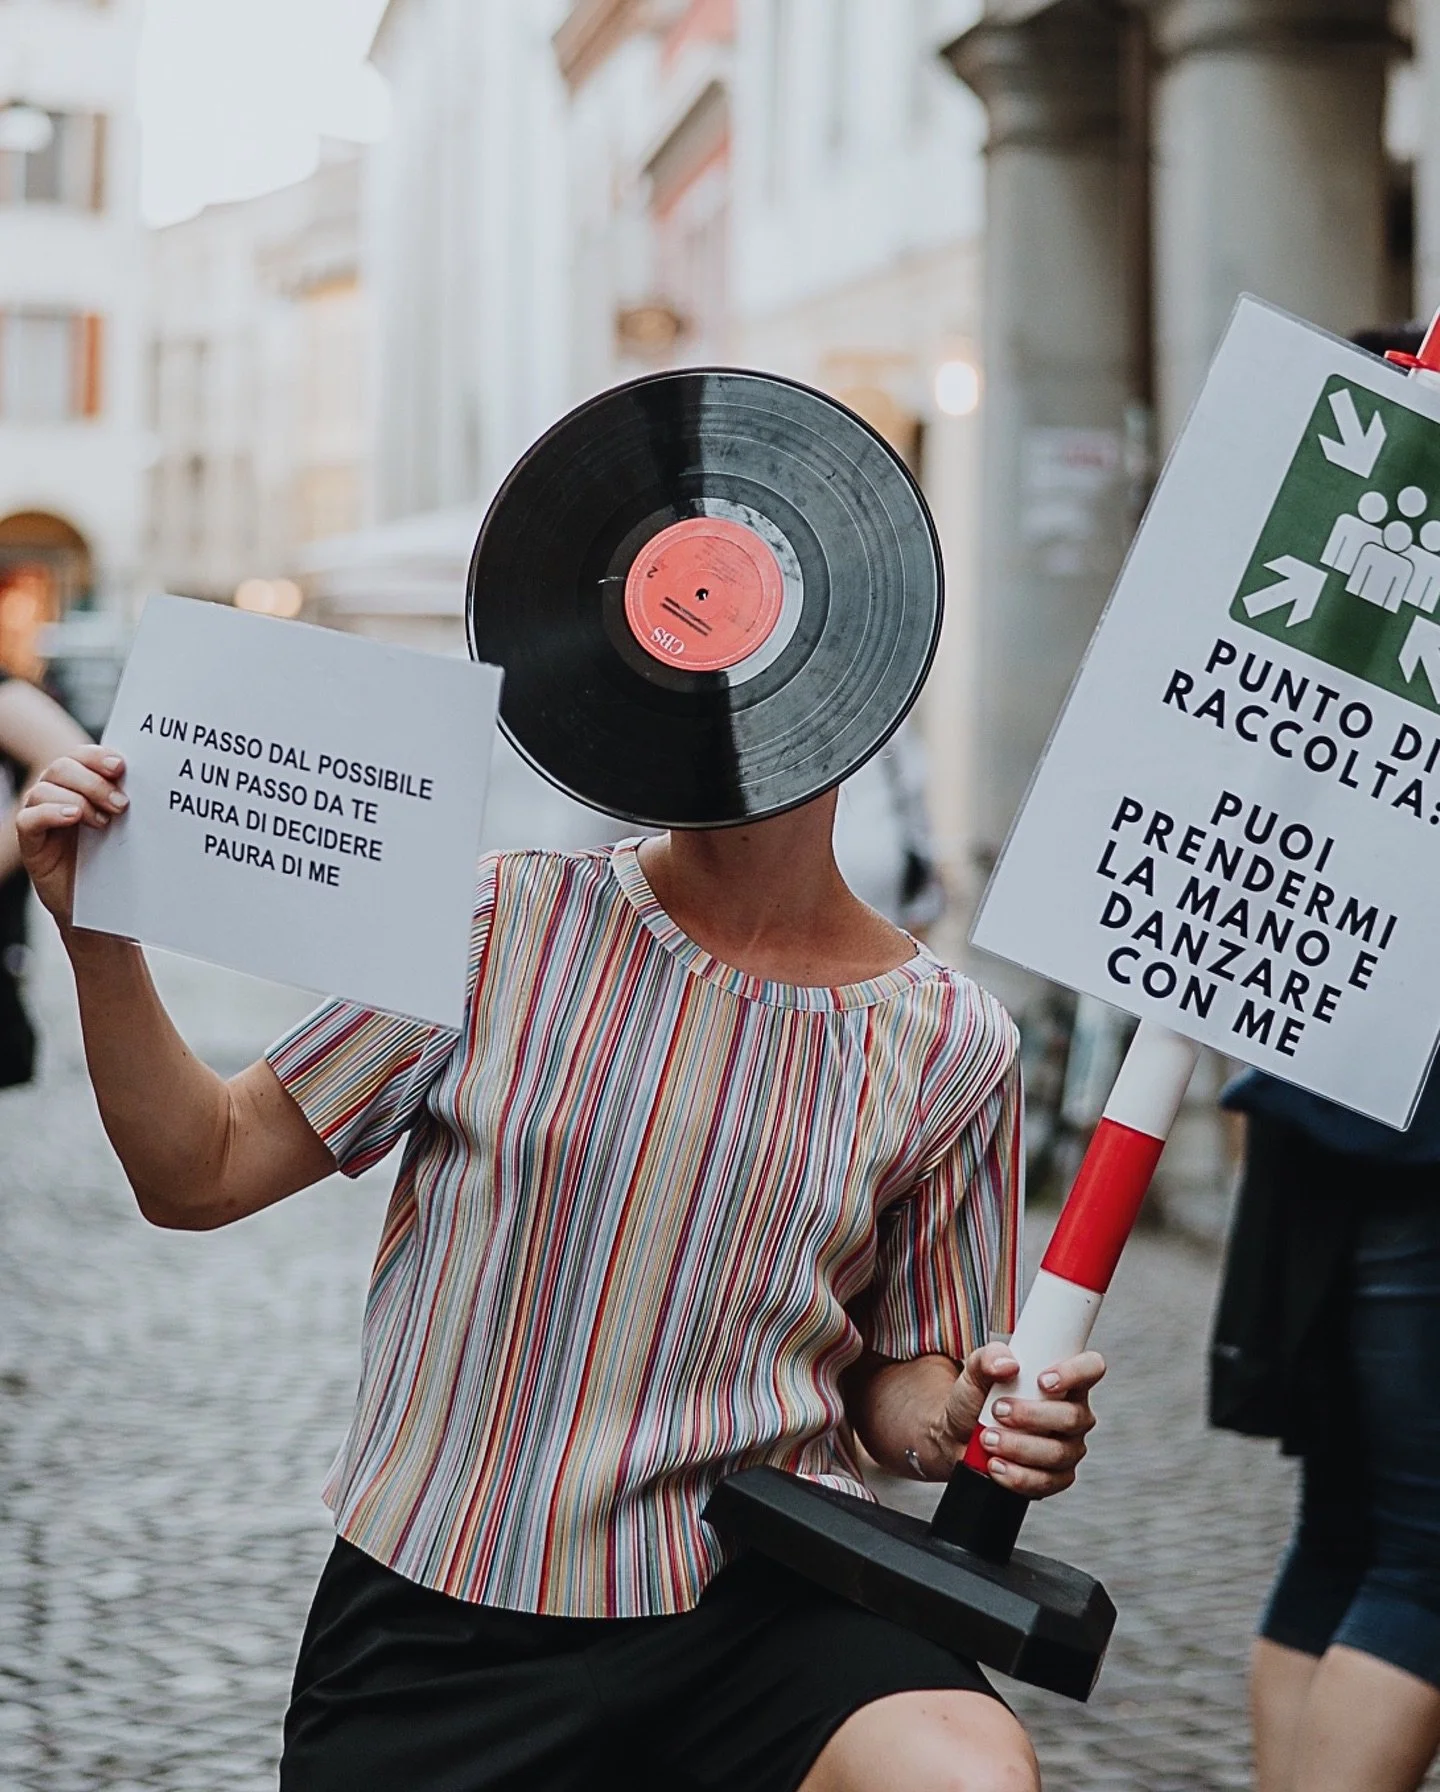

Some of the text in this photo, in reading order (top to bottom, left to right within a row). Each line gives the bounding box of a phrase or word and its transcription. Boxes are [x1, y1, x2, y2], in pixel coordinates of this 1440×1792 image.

[647, 565, 658, 578] 2
[650, 626, 685, 655] CBS
[1204, 638, 1440, 774] PUNTO DI
[139, 713, 433, 801] A UN PASSO DAL POSSIBILE
[178, 758, 378, 824] A UN PASSO DA TE
[169, 790, 383, 862] PAURA DI DECIDERE
[204, 833, 340, 887] PAURA DI ME
[1210, 790, 1335, 873] PUOI
[1096, 839, 1379, 991] LA MANO E
[1111, 796, 1398, 950] PRENDERMI
[1099, 890, 1342, 1024] DANZARE
[1107, 946, 1306, 1057] CON ME
